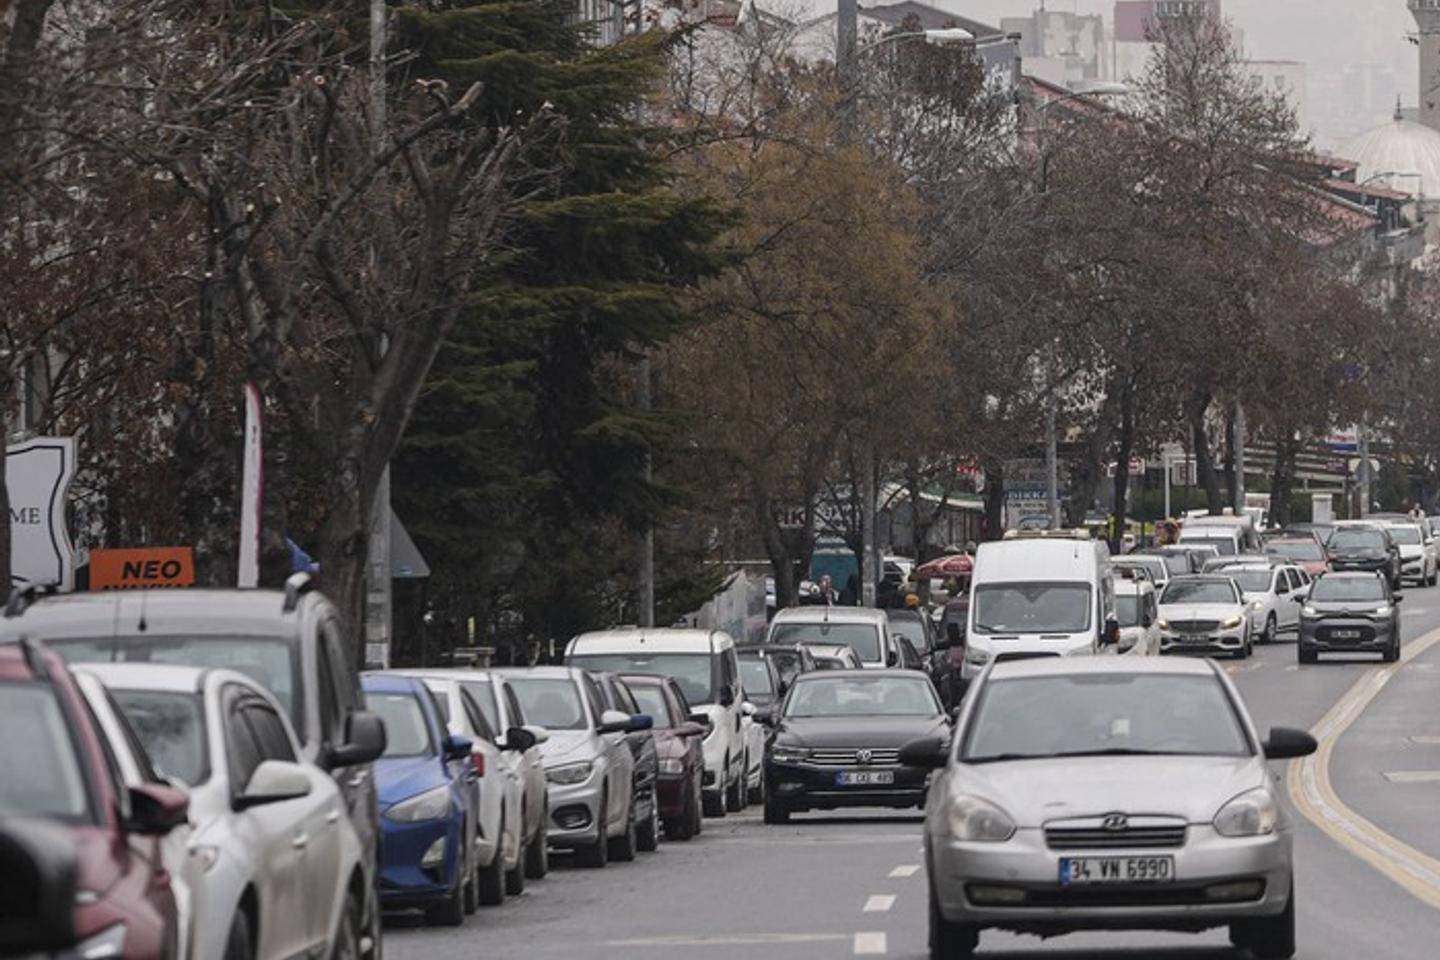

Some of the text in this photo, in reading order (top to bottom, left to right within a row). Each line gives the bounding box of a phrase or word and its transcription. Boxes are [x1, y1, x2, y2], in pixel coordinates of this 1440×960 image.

[121, 560, 182, 580] NEO
[1071, 860, 1091, 880] 34
[1126, 859, 1169, 878] 6990
